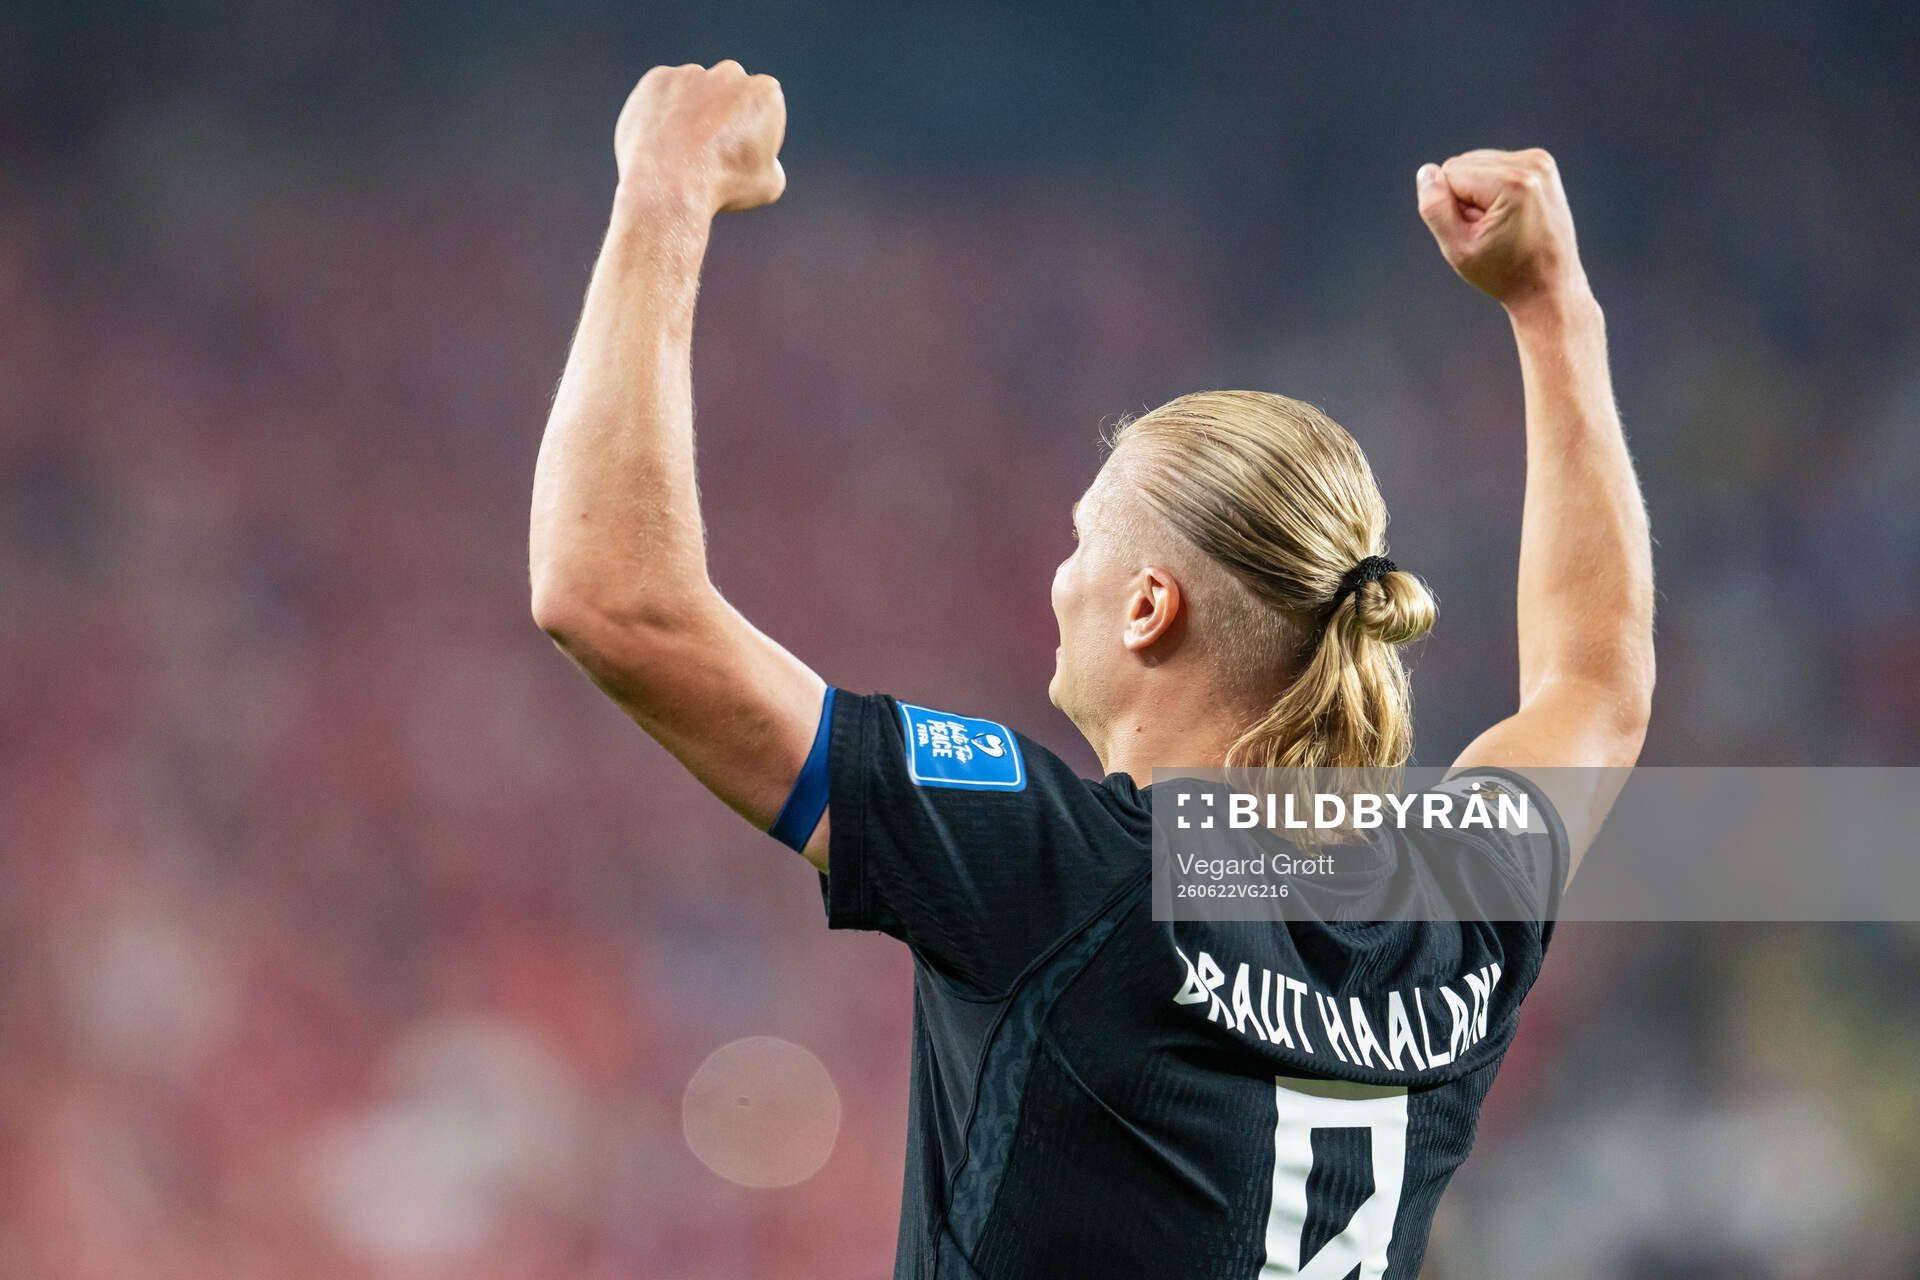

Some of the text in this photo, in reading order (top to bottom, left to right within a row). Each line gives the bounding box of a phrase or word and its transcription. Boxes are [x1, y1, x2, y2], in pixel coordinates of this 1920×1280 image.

[916, 723, 930, 746] FIFA
[926, 719, 953, 759] PEACE
[1314, 962, 1502, 1072] HAALAN
